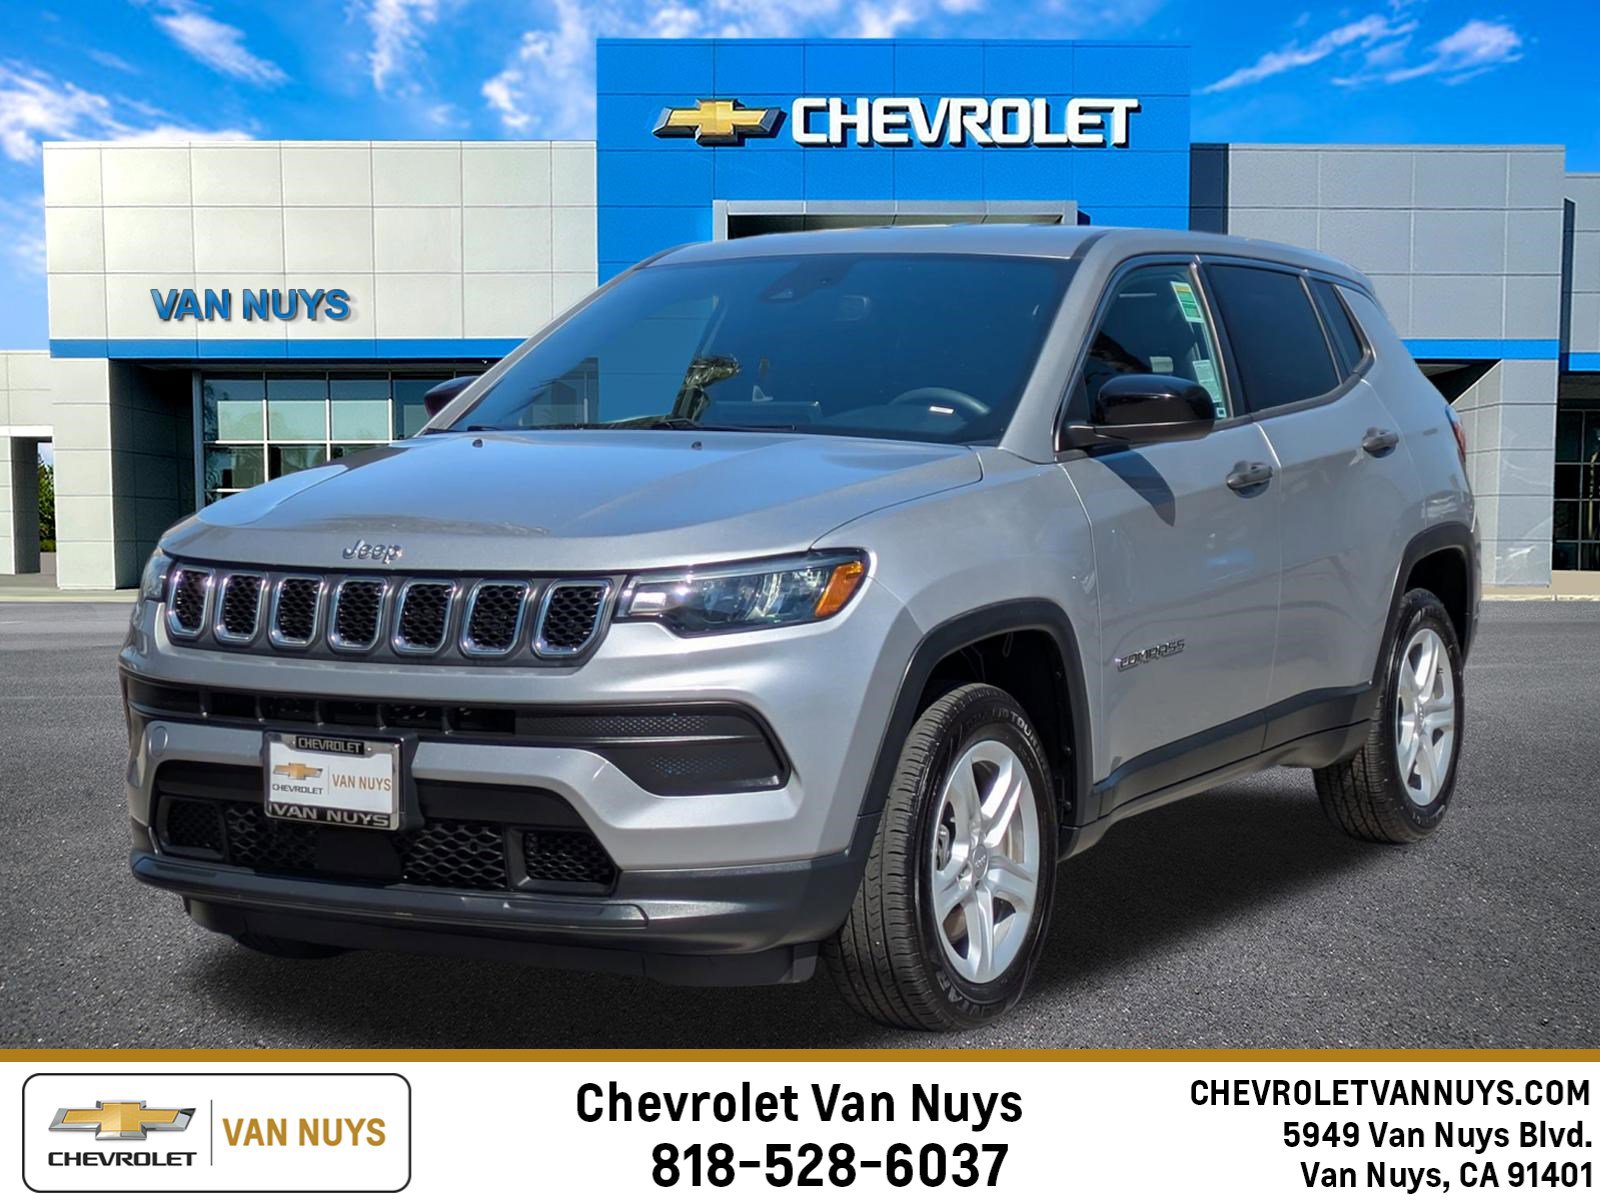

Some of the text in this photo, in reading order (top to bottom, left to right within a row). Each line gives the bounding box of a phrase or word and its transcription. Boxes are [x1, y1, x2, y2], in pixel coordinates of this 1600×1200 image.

[792, 97, 1139, 146] CHEVROLET
[150, 289, 350, 320] VAN NUYS
[343, 540, 402, 564] Jeep
[297, 737, 362, 753] CHEVROLET
[272, 783, 324, 795] CHEVROLET
[332, 774, 391, 791] VAN NUYS
[271, 803, 389, 827] VAN NUYS
